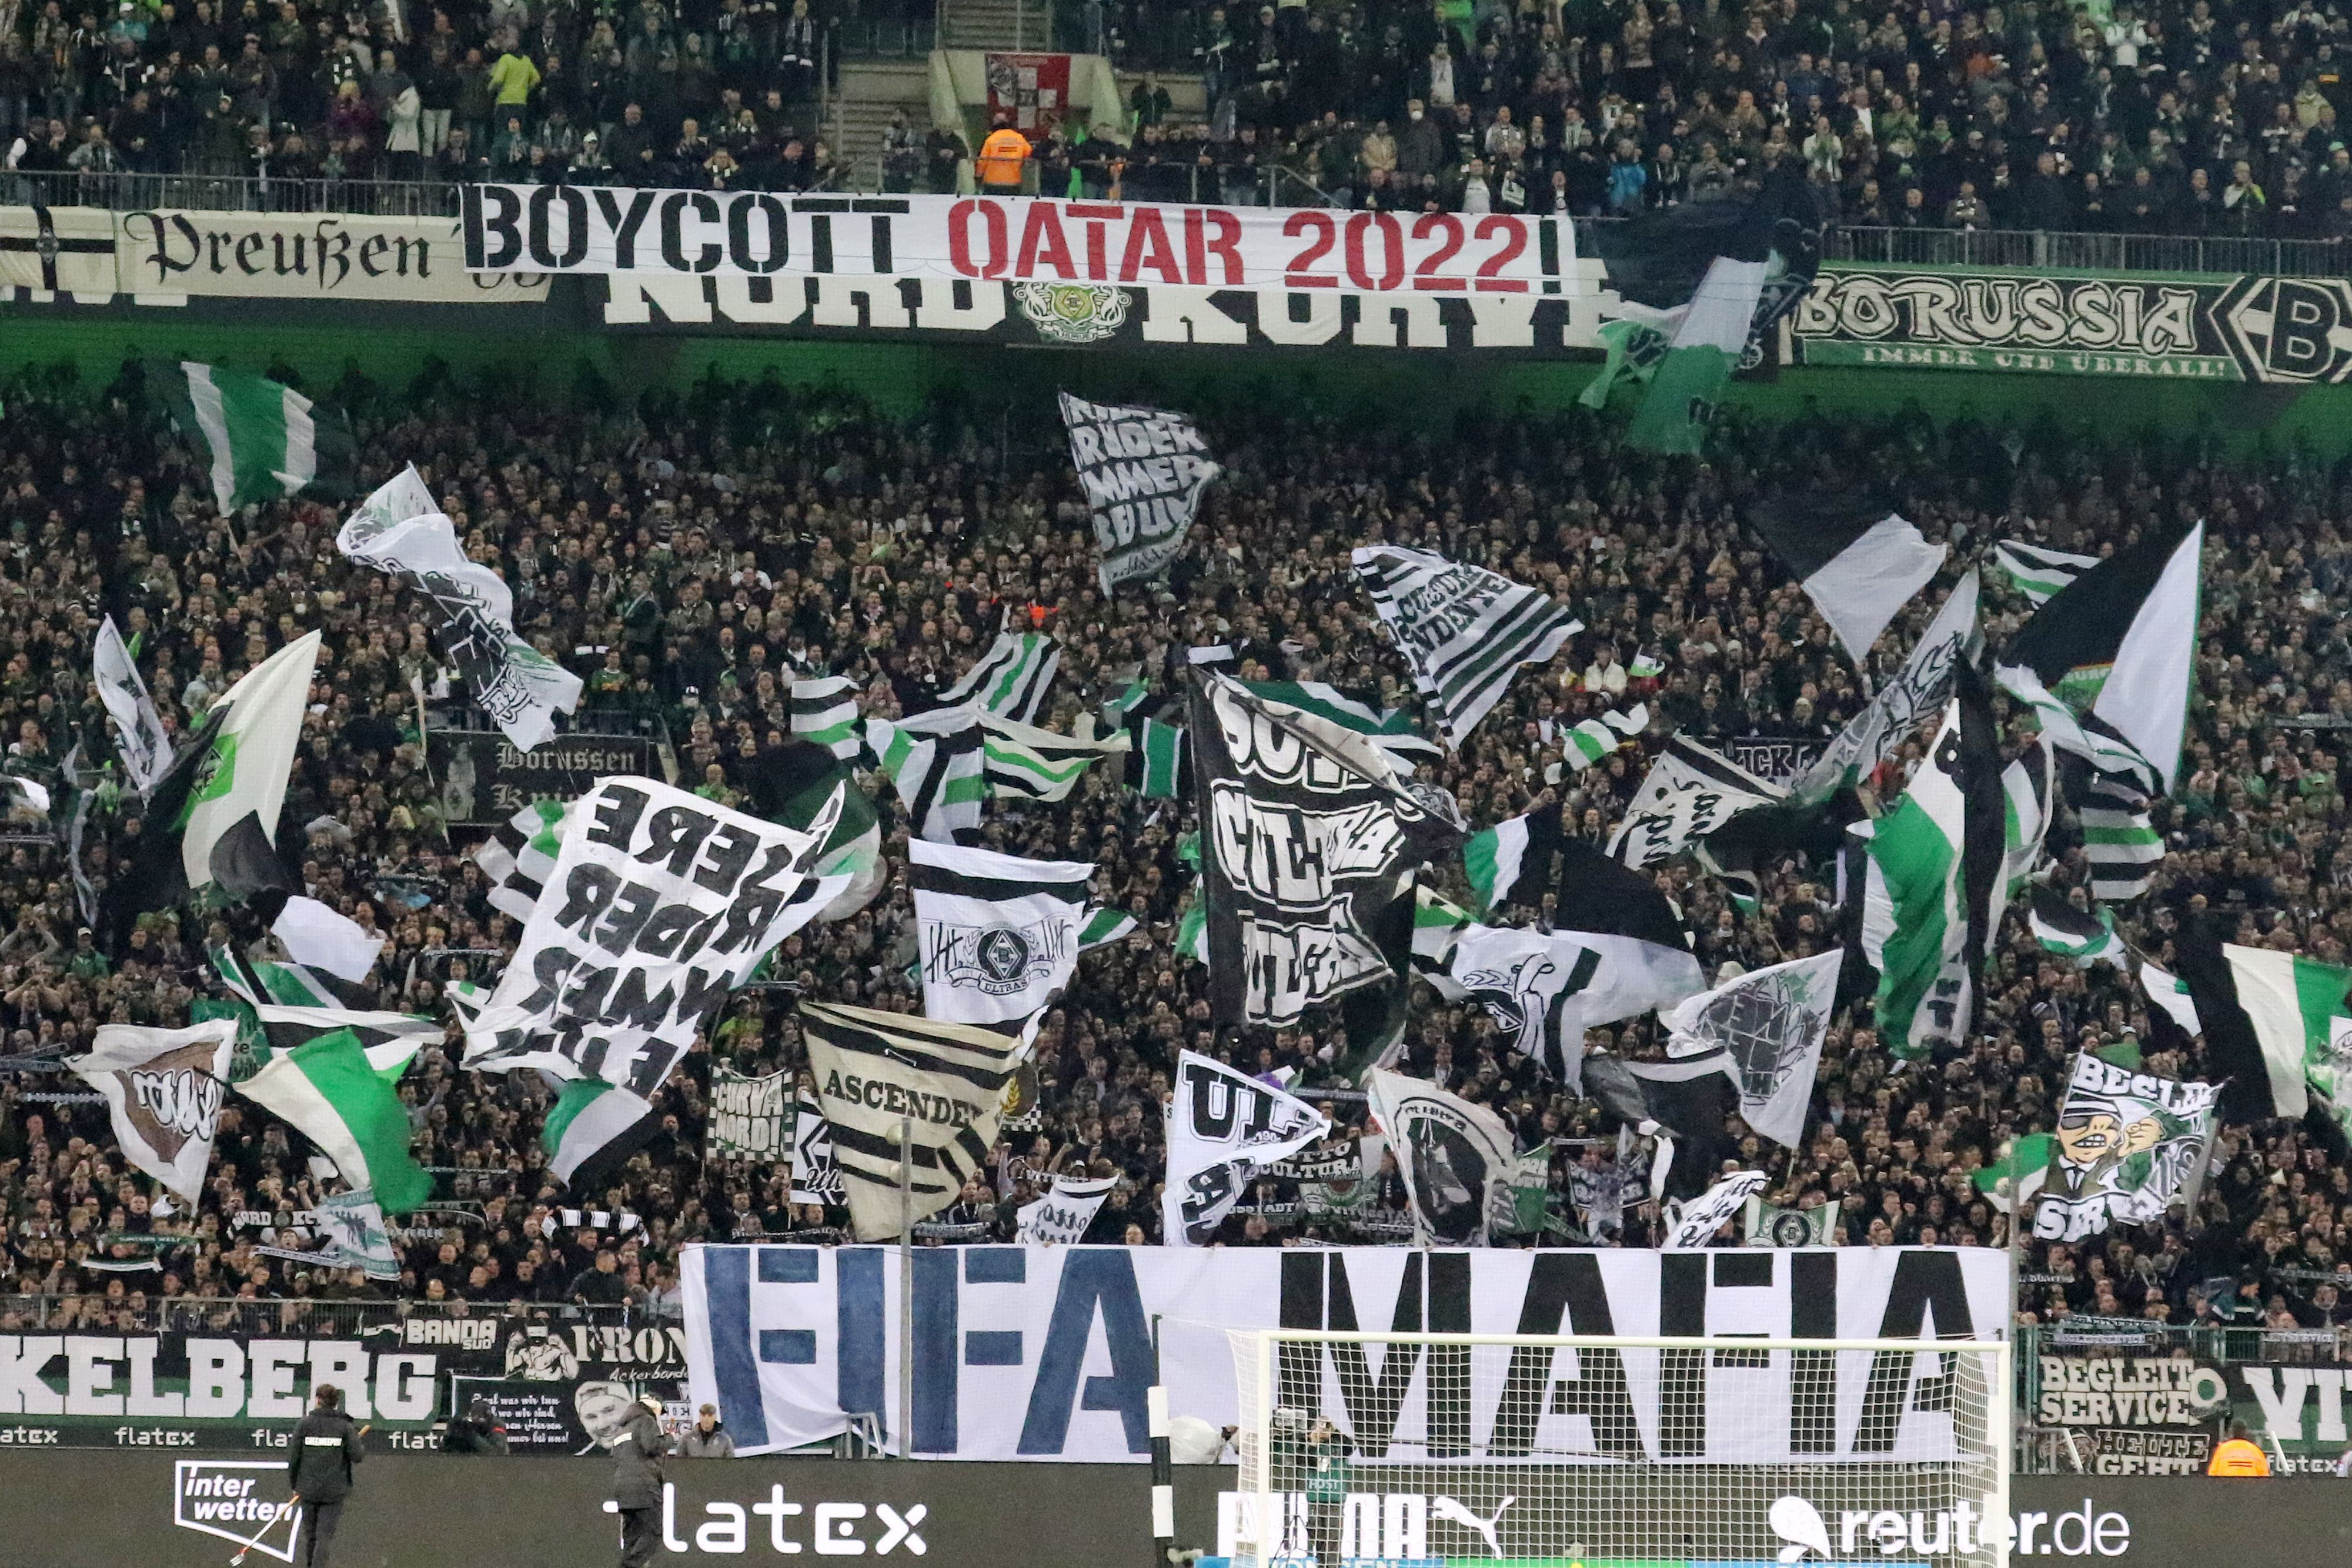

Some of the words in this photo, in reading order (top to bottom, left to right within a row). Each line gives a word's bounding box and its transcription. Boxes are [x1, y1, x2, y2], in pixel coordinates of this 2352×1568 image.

[124, 212, 432, 289] Preußen
[465, 185, 910, 274] BOYCOTT
[948, 199, 1244, 286] QATAR
[1282, 211, 1560, 295] 2022!
[1793, 272, 2199, 356] BORUSSIA
[1863, 347, 1976, 367] IMMER
[1997, 353, 2055, 370] UND
[2071, 354, 2226, 377] ÜBERALL!
[984, 978, 1027, 993] ULTRAS
[716, 1074, 784, 1117] CURVA
[715, 1110, 781, 1155] NORD!
[407, 1319, 497, 1345] BANDA
[705, 1246, 1154, 1455] FIFA
[1278, 1251, 2000, 1458] MAFIA
[2040, 1356, 2195, 1392] BEGLEIT
[2040, 1390, 2191, 1426] SERVICE
[115, 1426, 196, 1446] flatex
[185, 1468, 256, 1497] inter
[1308, 1479, 1338, 1490] HOST
[193, 1497, 294, 1522] wetten
